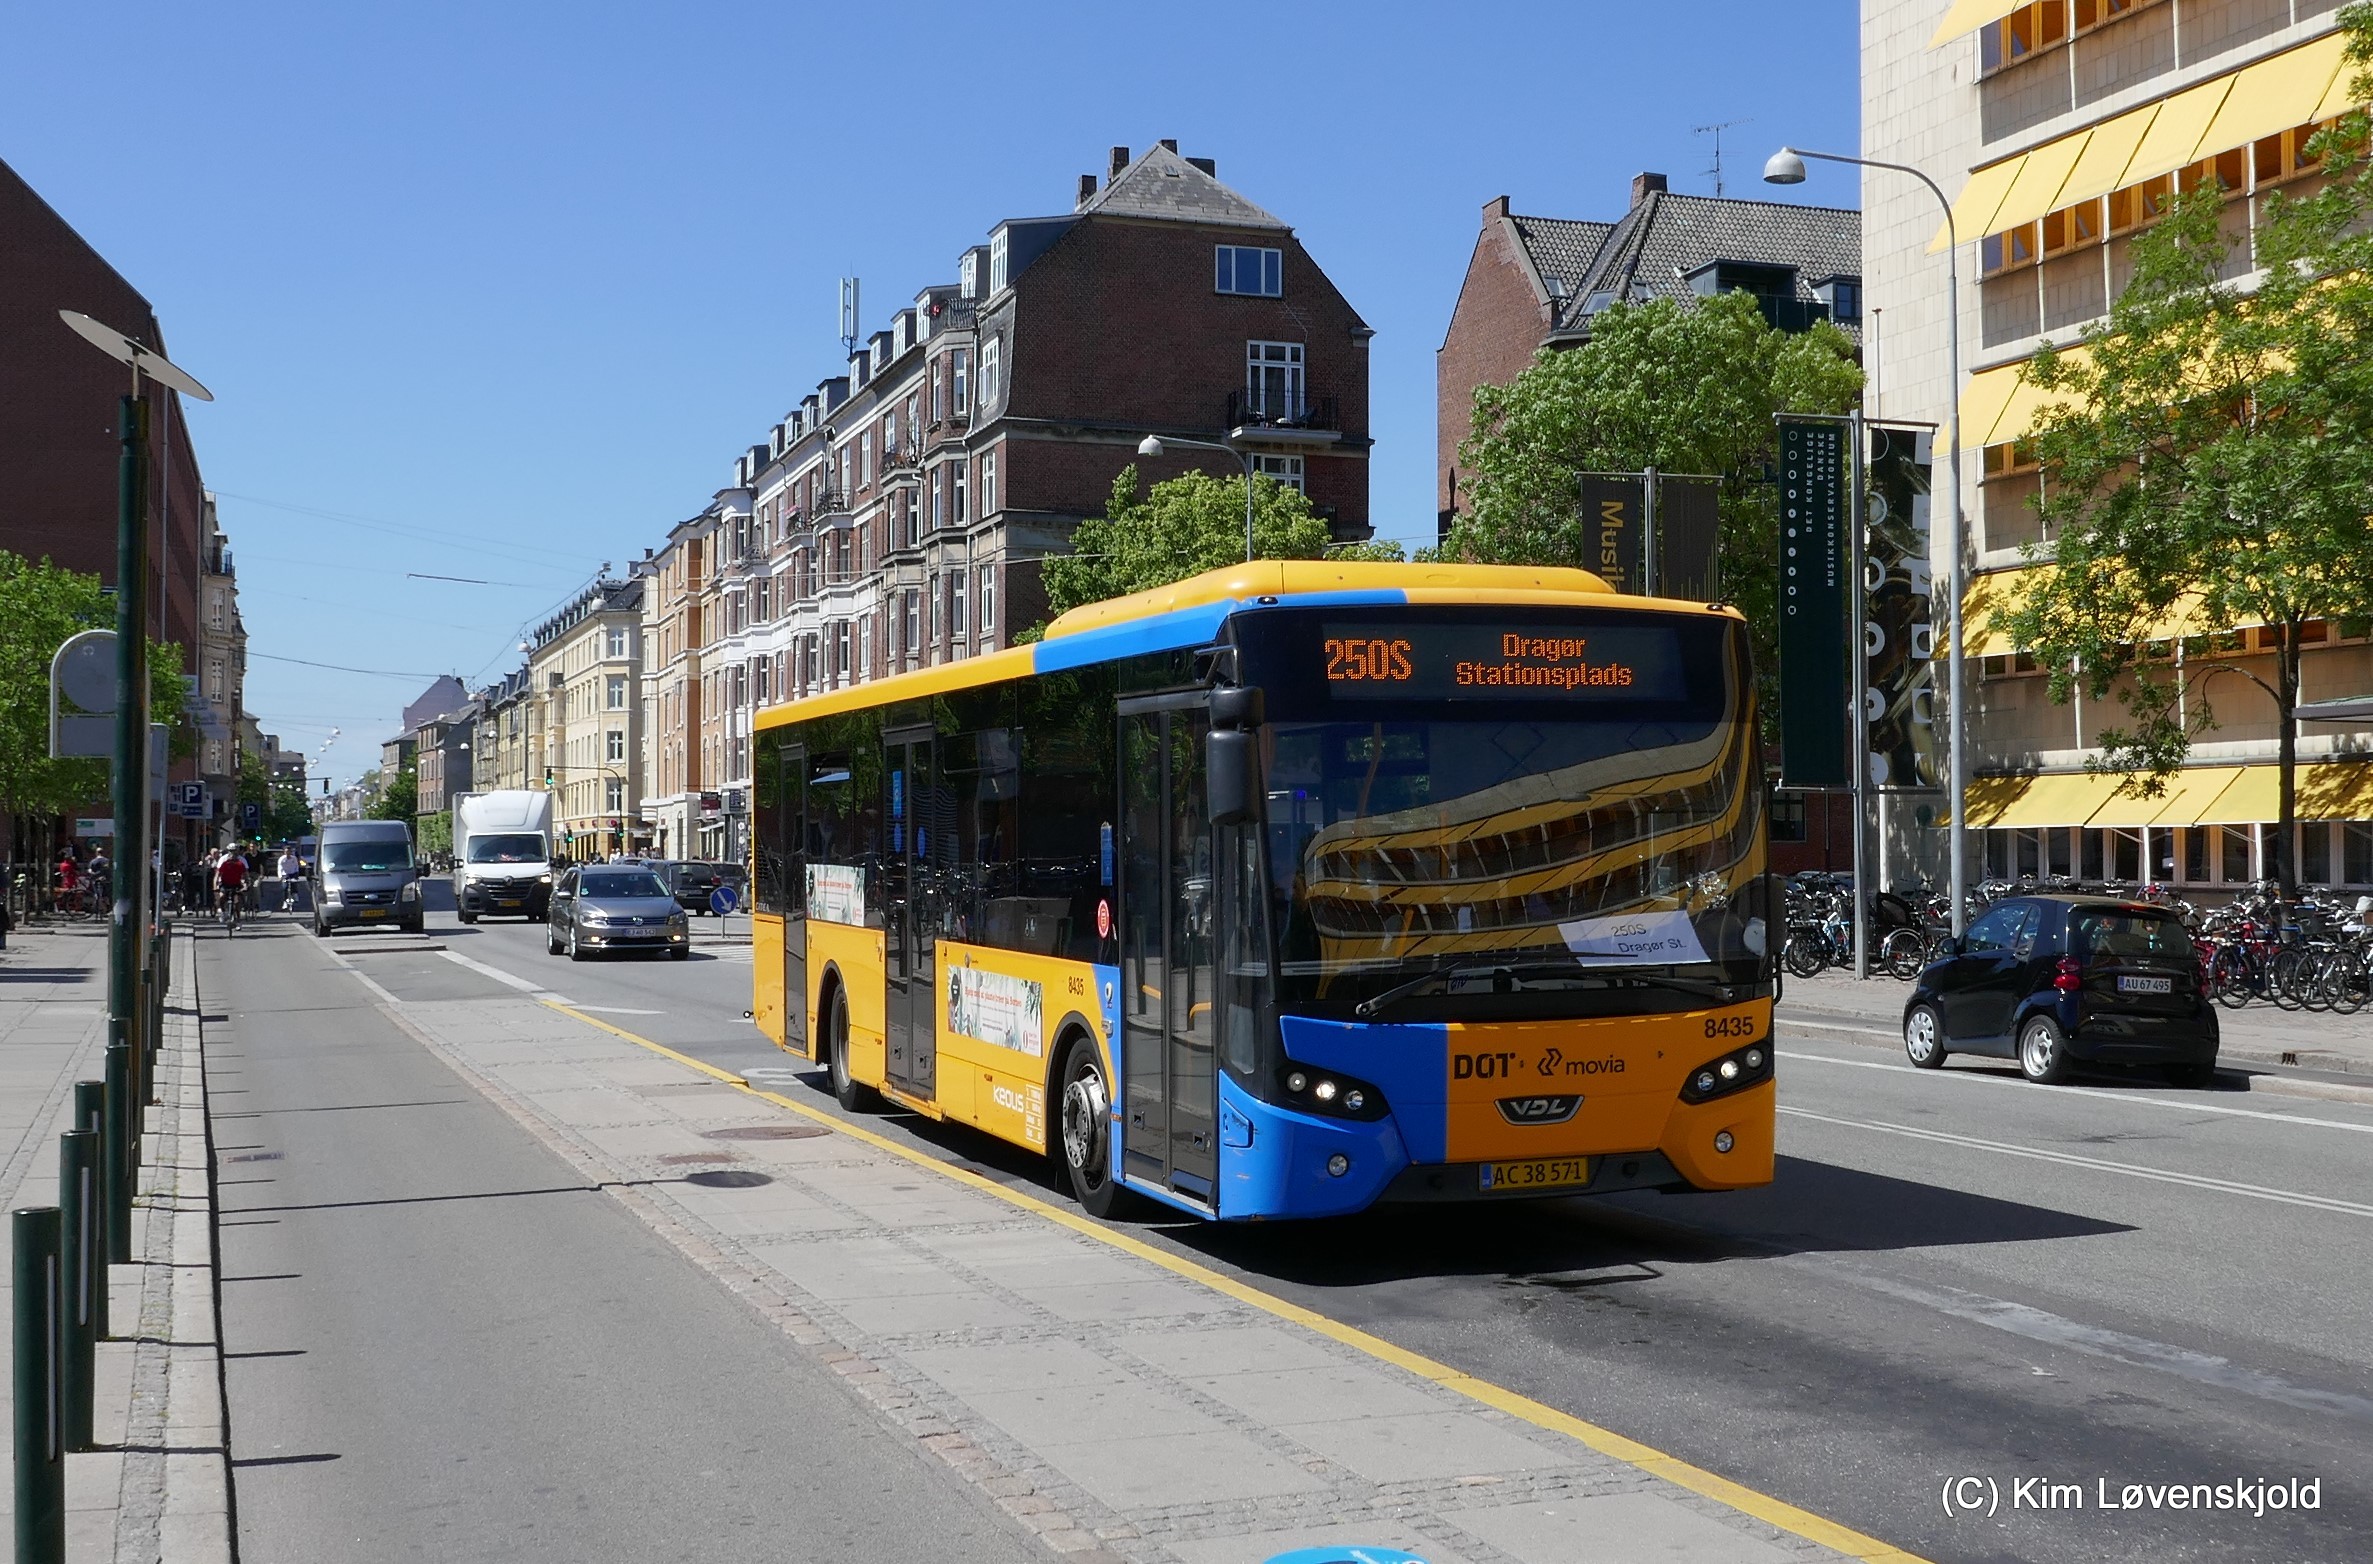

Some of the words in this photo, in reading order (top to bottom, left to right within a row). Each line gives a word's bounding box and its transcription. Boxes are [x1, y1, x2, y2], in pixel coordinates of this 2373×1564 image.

[1806, 432, 1814, 503] KONGELIGE
[1817, 433, 1825, 481] DANSKE
[1805, 510, 1813, 533] DET
[1827, 433, 1836, 587] MUSIKKONSERVATORIUM
[1325, 638, 1412, 680] 250S
[1502, 633, 1586, 662] Dragør
[1456, 661, 1633, 690] Stationsplads
[186, 786, 199, 803] P
[1611, 923, 1647, 937] 250S
[1618, 941, 1664, 953] Dragør
[1069, 976, 1084, 996] 8435
[2125, 979, 2138, 990] AU
[2140, 980, 2151, 990] 67
[2153, 981, 2170, 991] 495
[1704, 1016, 1754, 1039] 8435
[1566, 1054, 1625, 1075] movia
[1510, 1099, 1566, 1116] VDL
[1493, 1165, 1518, 1185] AC
[1523, 1164, 1545, 1183] 38
[1550, 1161, 1581, 1181] 571
